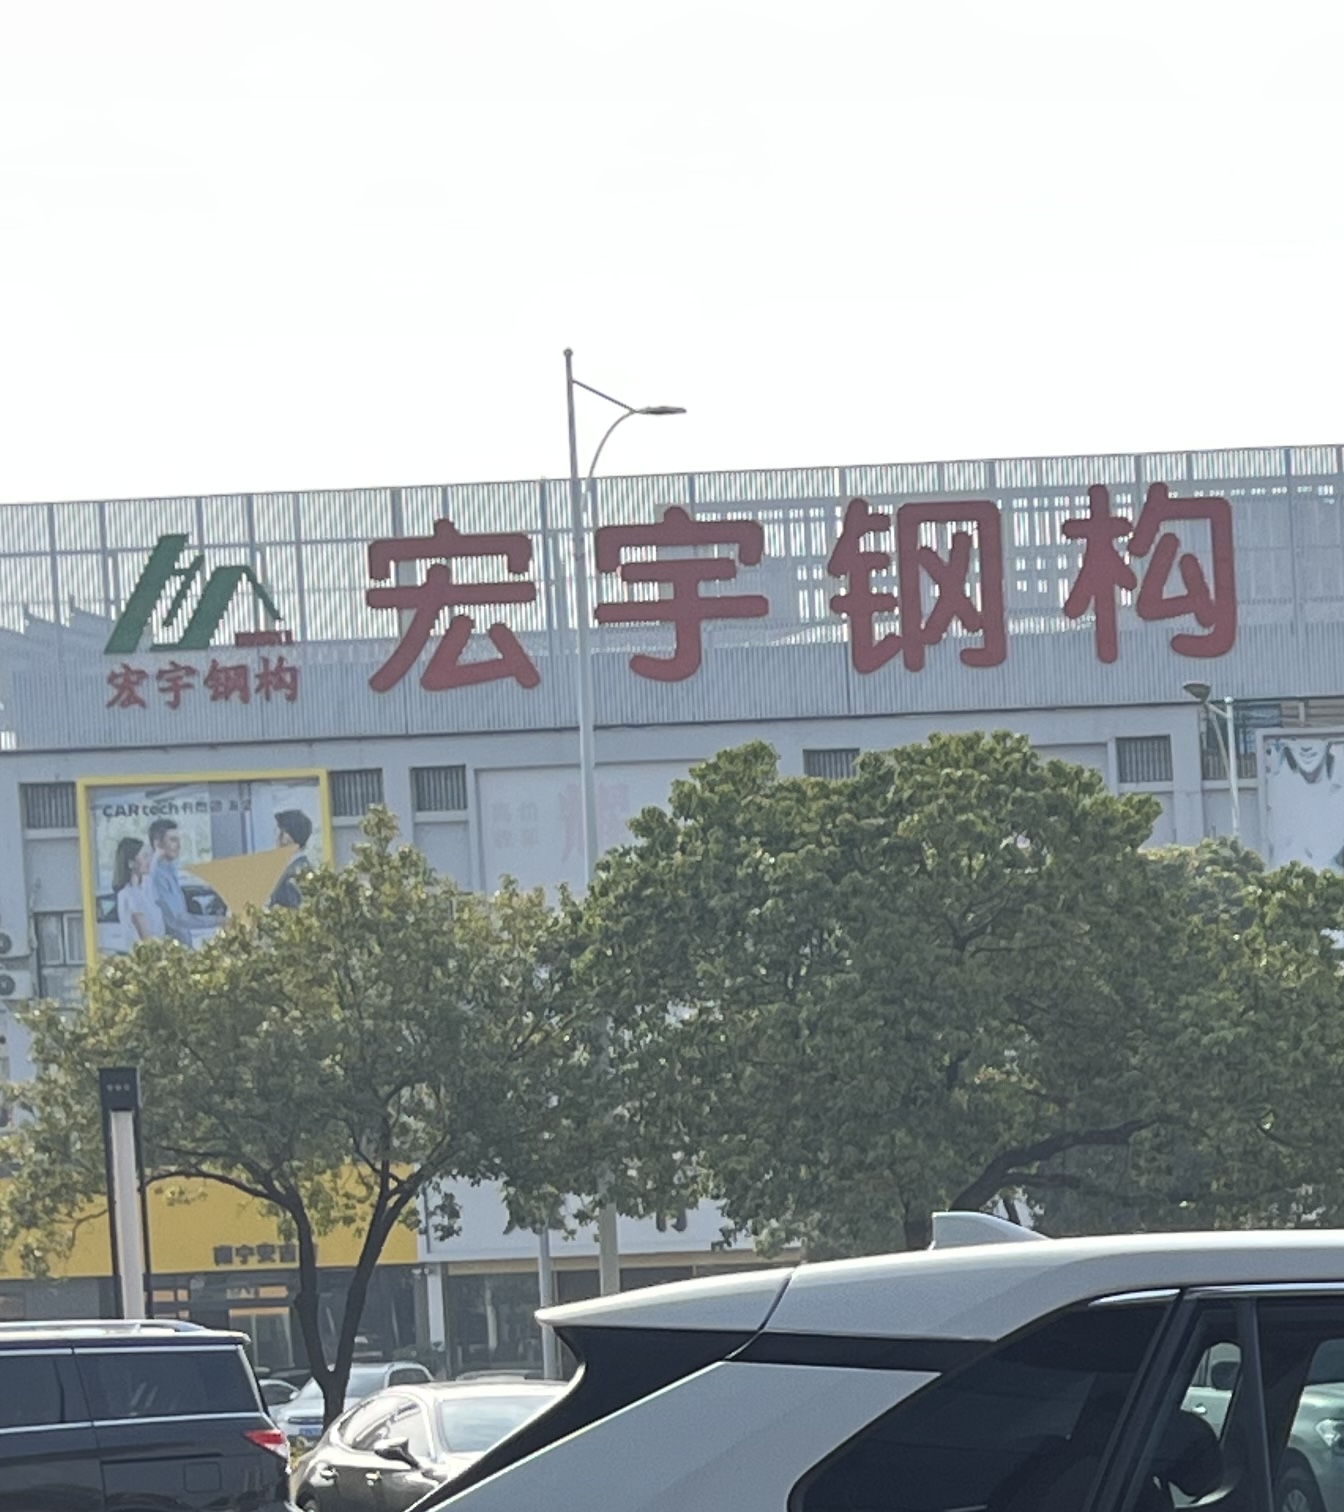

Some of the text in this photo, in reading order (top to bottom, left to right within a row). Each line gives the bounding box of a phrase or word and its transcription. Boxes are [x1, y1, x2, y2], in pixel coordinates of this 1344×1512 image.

[366, 482, 1238, 694] 宏宇钢构
[105, 655, 299, 709] 宏宇钢构
